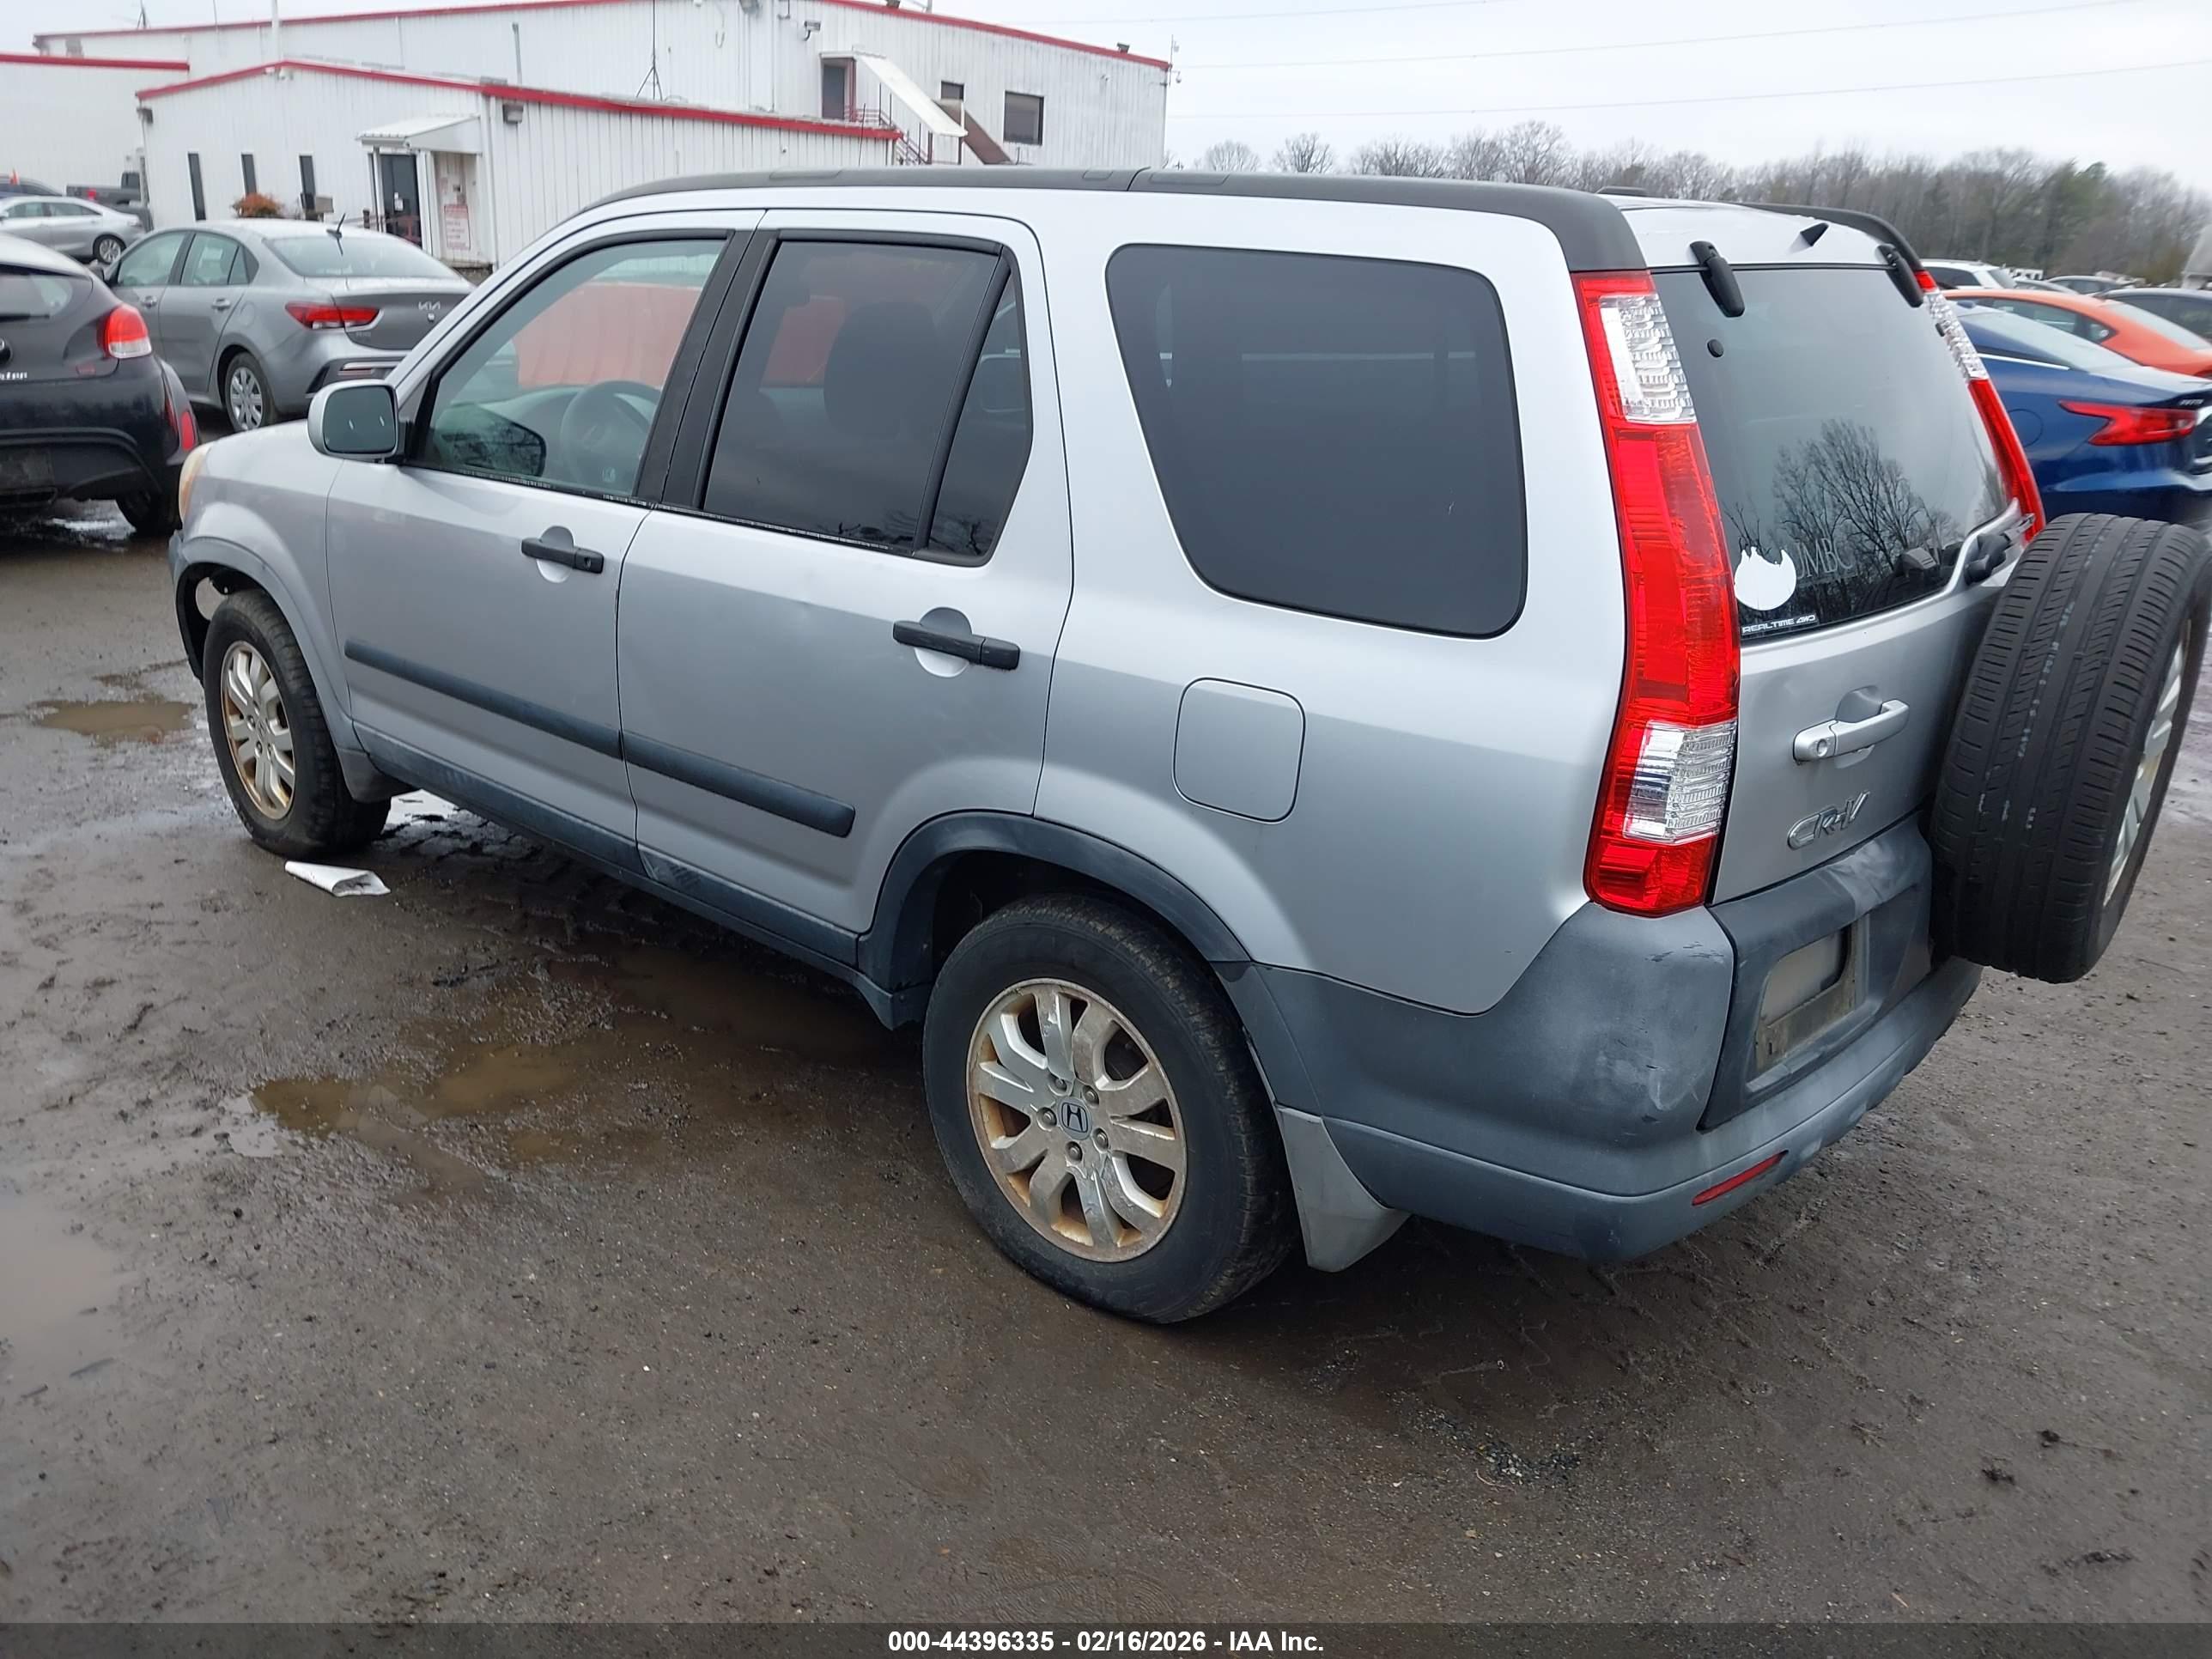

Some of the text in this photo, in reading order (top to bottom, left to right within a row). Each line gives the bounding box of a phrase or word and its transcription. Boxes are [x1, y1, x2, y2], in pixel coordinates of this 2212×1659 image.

[1741, 614, 1816, 634] REALTIME 4WD
[1787, 790, 1870, 850] CR-V
